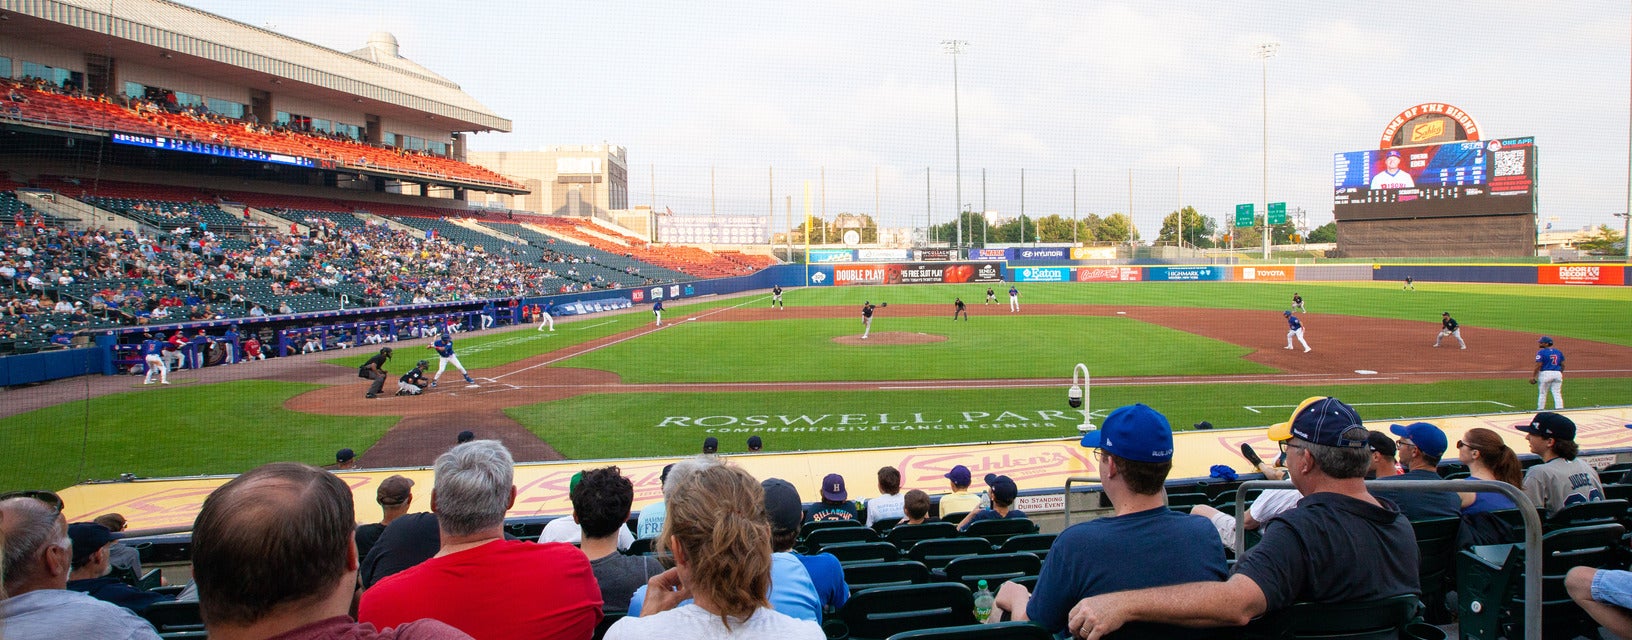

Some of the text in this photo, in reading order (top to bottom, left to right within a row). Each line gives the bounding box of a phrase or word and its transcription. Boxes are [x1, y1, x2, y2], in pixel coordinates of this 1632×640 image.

[1383, 104, 1476, 141] HOME OF THE BISONS
[186, 142, 192, 152] 3
[196, 142, 202, 152] 4
[204, 144, 210, 154] 5
[212, 146, 218, 155] 6
[222, 146, 227, 156] 7
[836, 269, 884, 280] DOUBLE PLAY!
[1032, 268, 1062, 278] Eaton
[1550, 354, 1558, 366] 7
[656, 408, 1109, 427] ROSWELL PARK
[1568, 472, 1592, 490] JUDGE
[833, 484, 840, 492] H
